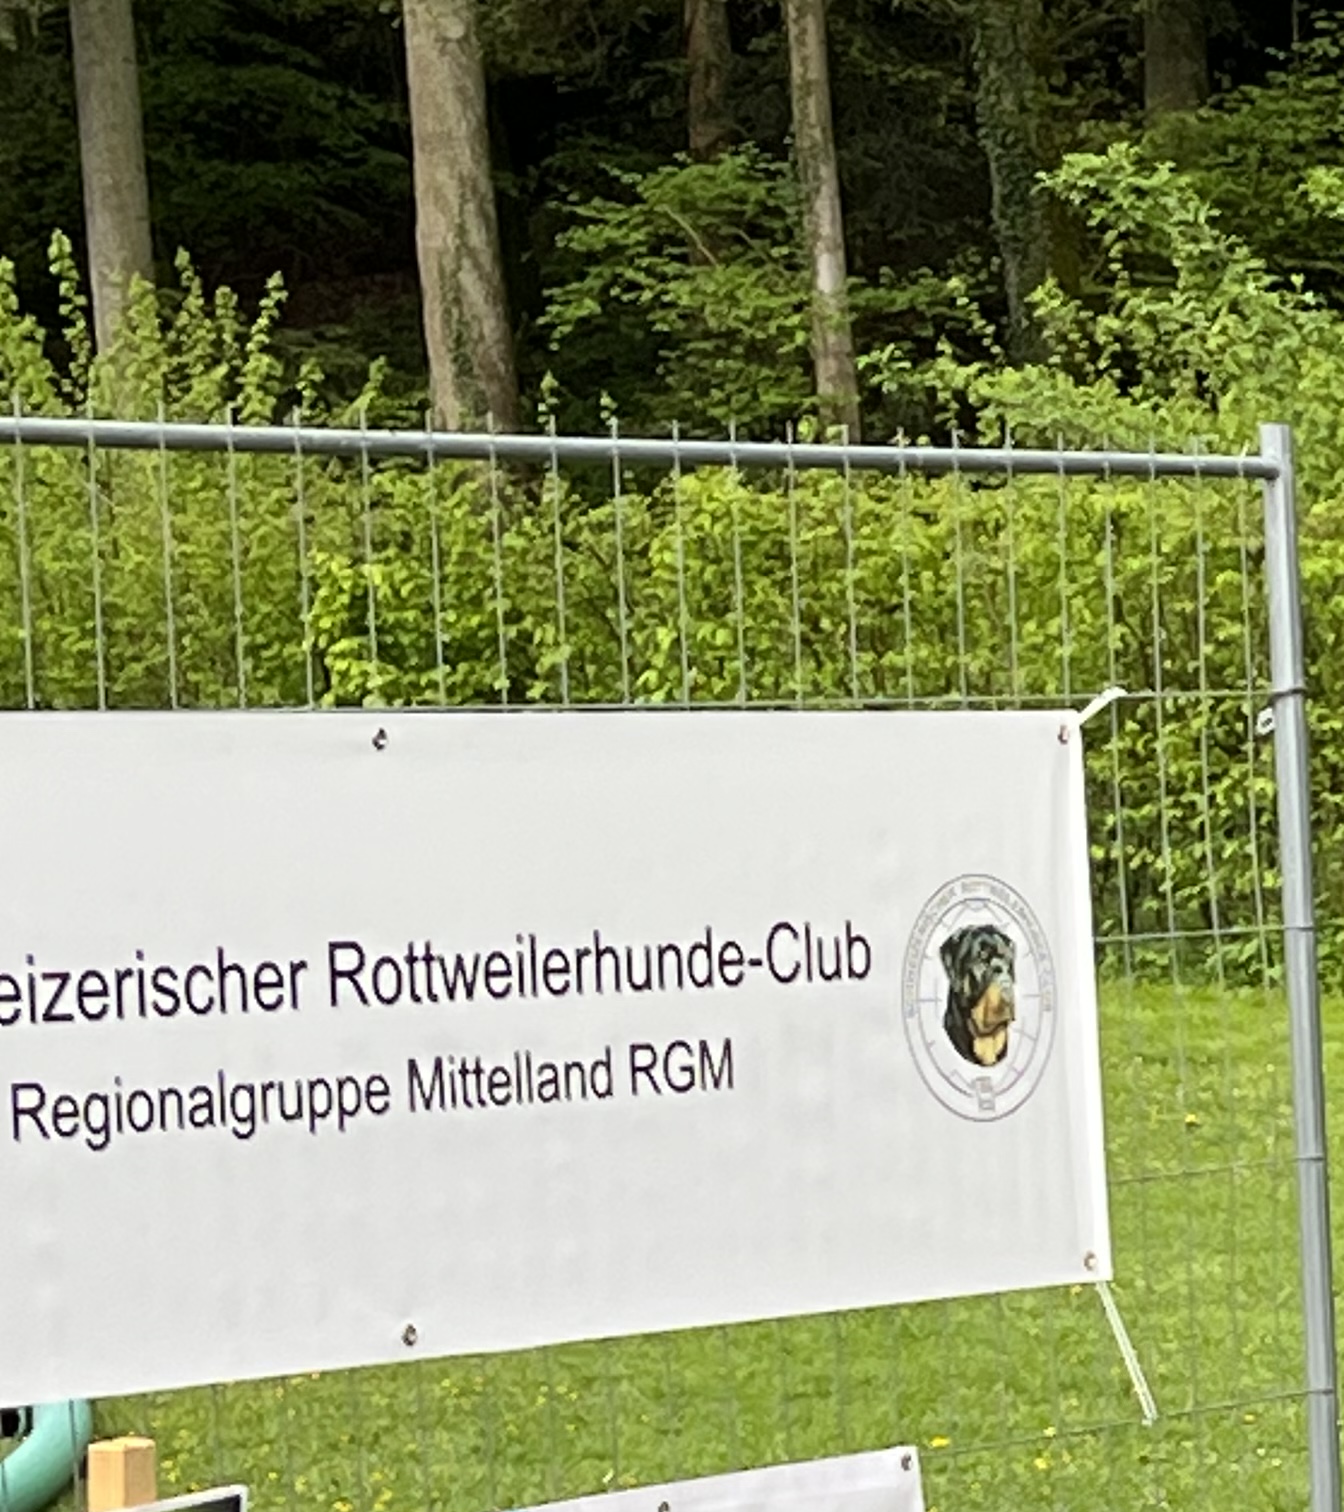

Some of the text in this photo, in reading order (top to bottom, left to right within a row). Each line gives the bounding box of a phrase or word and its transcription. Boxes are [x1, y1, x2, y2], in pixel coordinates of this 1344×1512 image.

[328, 919, 872, 1008] Rottweilerhunde-Club
[11, 1038, 735, 1152] Regionalgruppe Mittelland RGM
